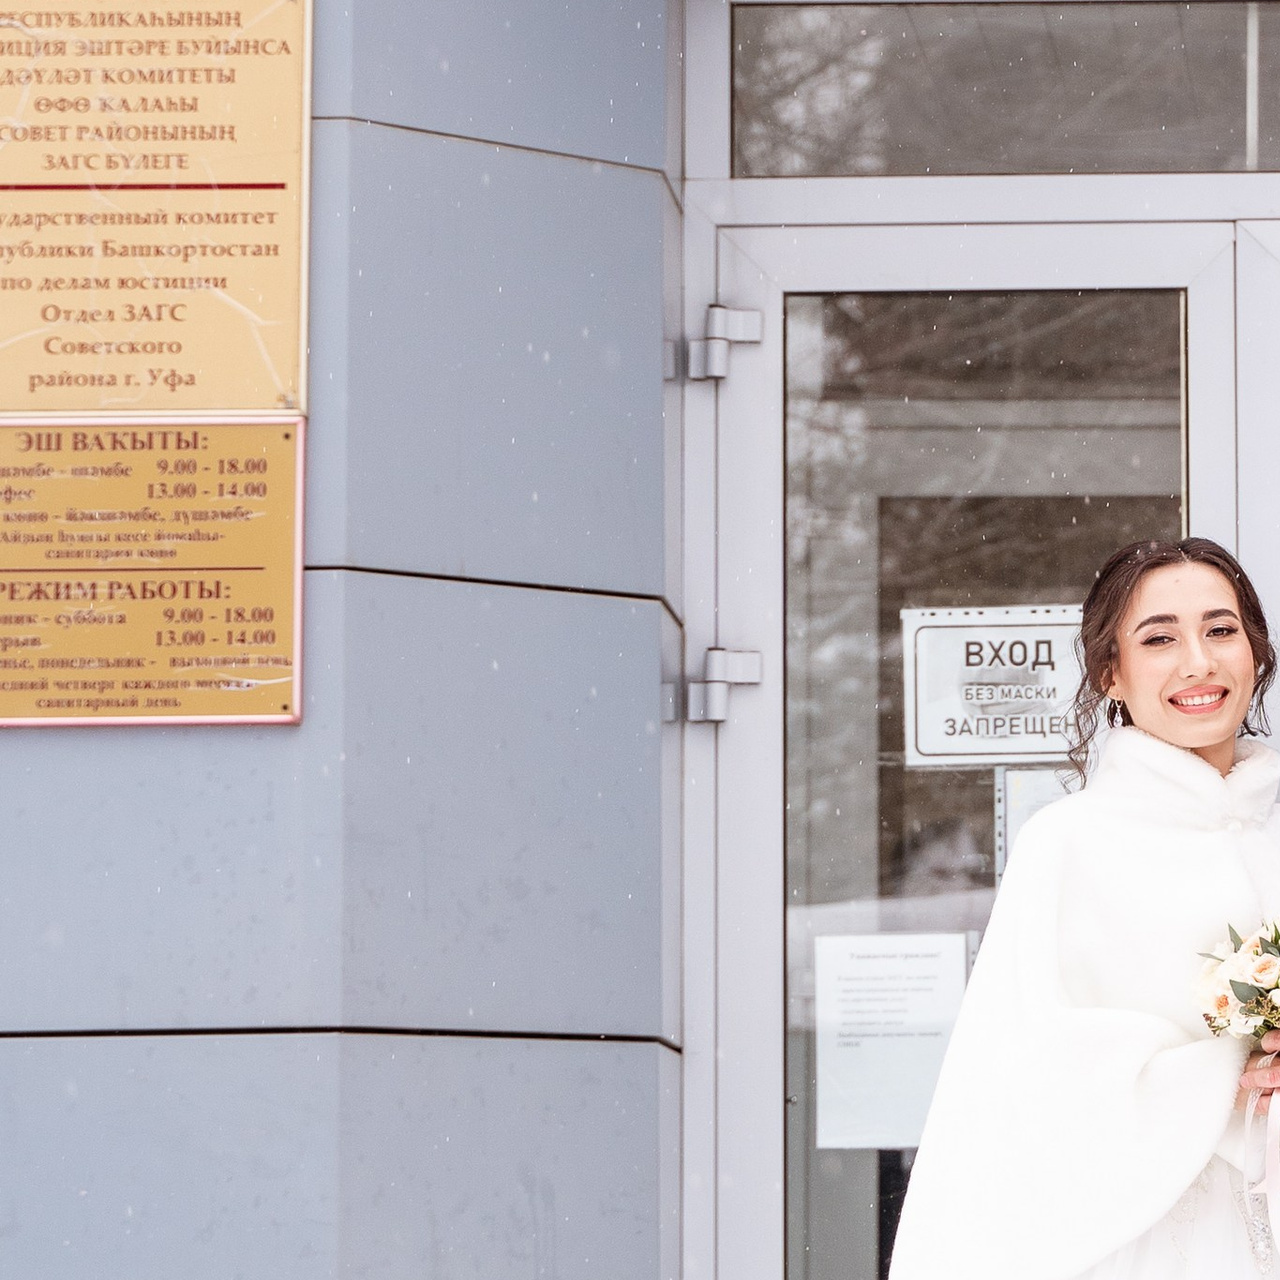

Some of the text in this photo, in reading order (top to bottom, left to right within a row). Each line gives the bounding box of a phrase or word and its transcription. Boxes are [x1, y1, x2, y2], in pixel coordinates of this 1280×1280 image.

[102, 66, 237, 85] КОМИТЕТЫ
[0, 124, 73, 143] СОВЕТ
[43, 152, 100, 170] ЗАГС
[174, 210, 279, 226] комитет
[100, 239, 280, 263] Башкортостан
[1, 275, 228, 293] по делам юстиции
[40, 303, 188, 324] Отдел ЗАГС
[43, 335, 183, 355] Советского
[28, 368, 197, 393] района г. Уфа
[15, 430, 63, 453] ЭШ
[156, 458, 198, 475] 9.00
[217, 457, 268, 475] 18.00
[147, 482, 197, 499] 13.00
[217, 481, 268, 498] 14.00
[107, 579, 231, 601] РАБОТЫ:
[54, 610, 127, 629] суббота
[162, 606, 204, 624] 9.00
[224, 606, 275, 624] 18.00
[155, 629, 206, 646] 13.00
[226, 629, 276, 645] 14.00
[38, 657, 146, 670] понедельник
[964, 639, 1056, 671] ВХОД
[964, 686, 1058, 701] БЕЗ МАСКИ
